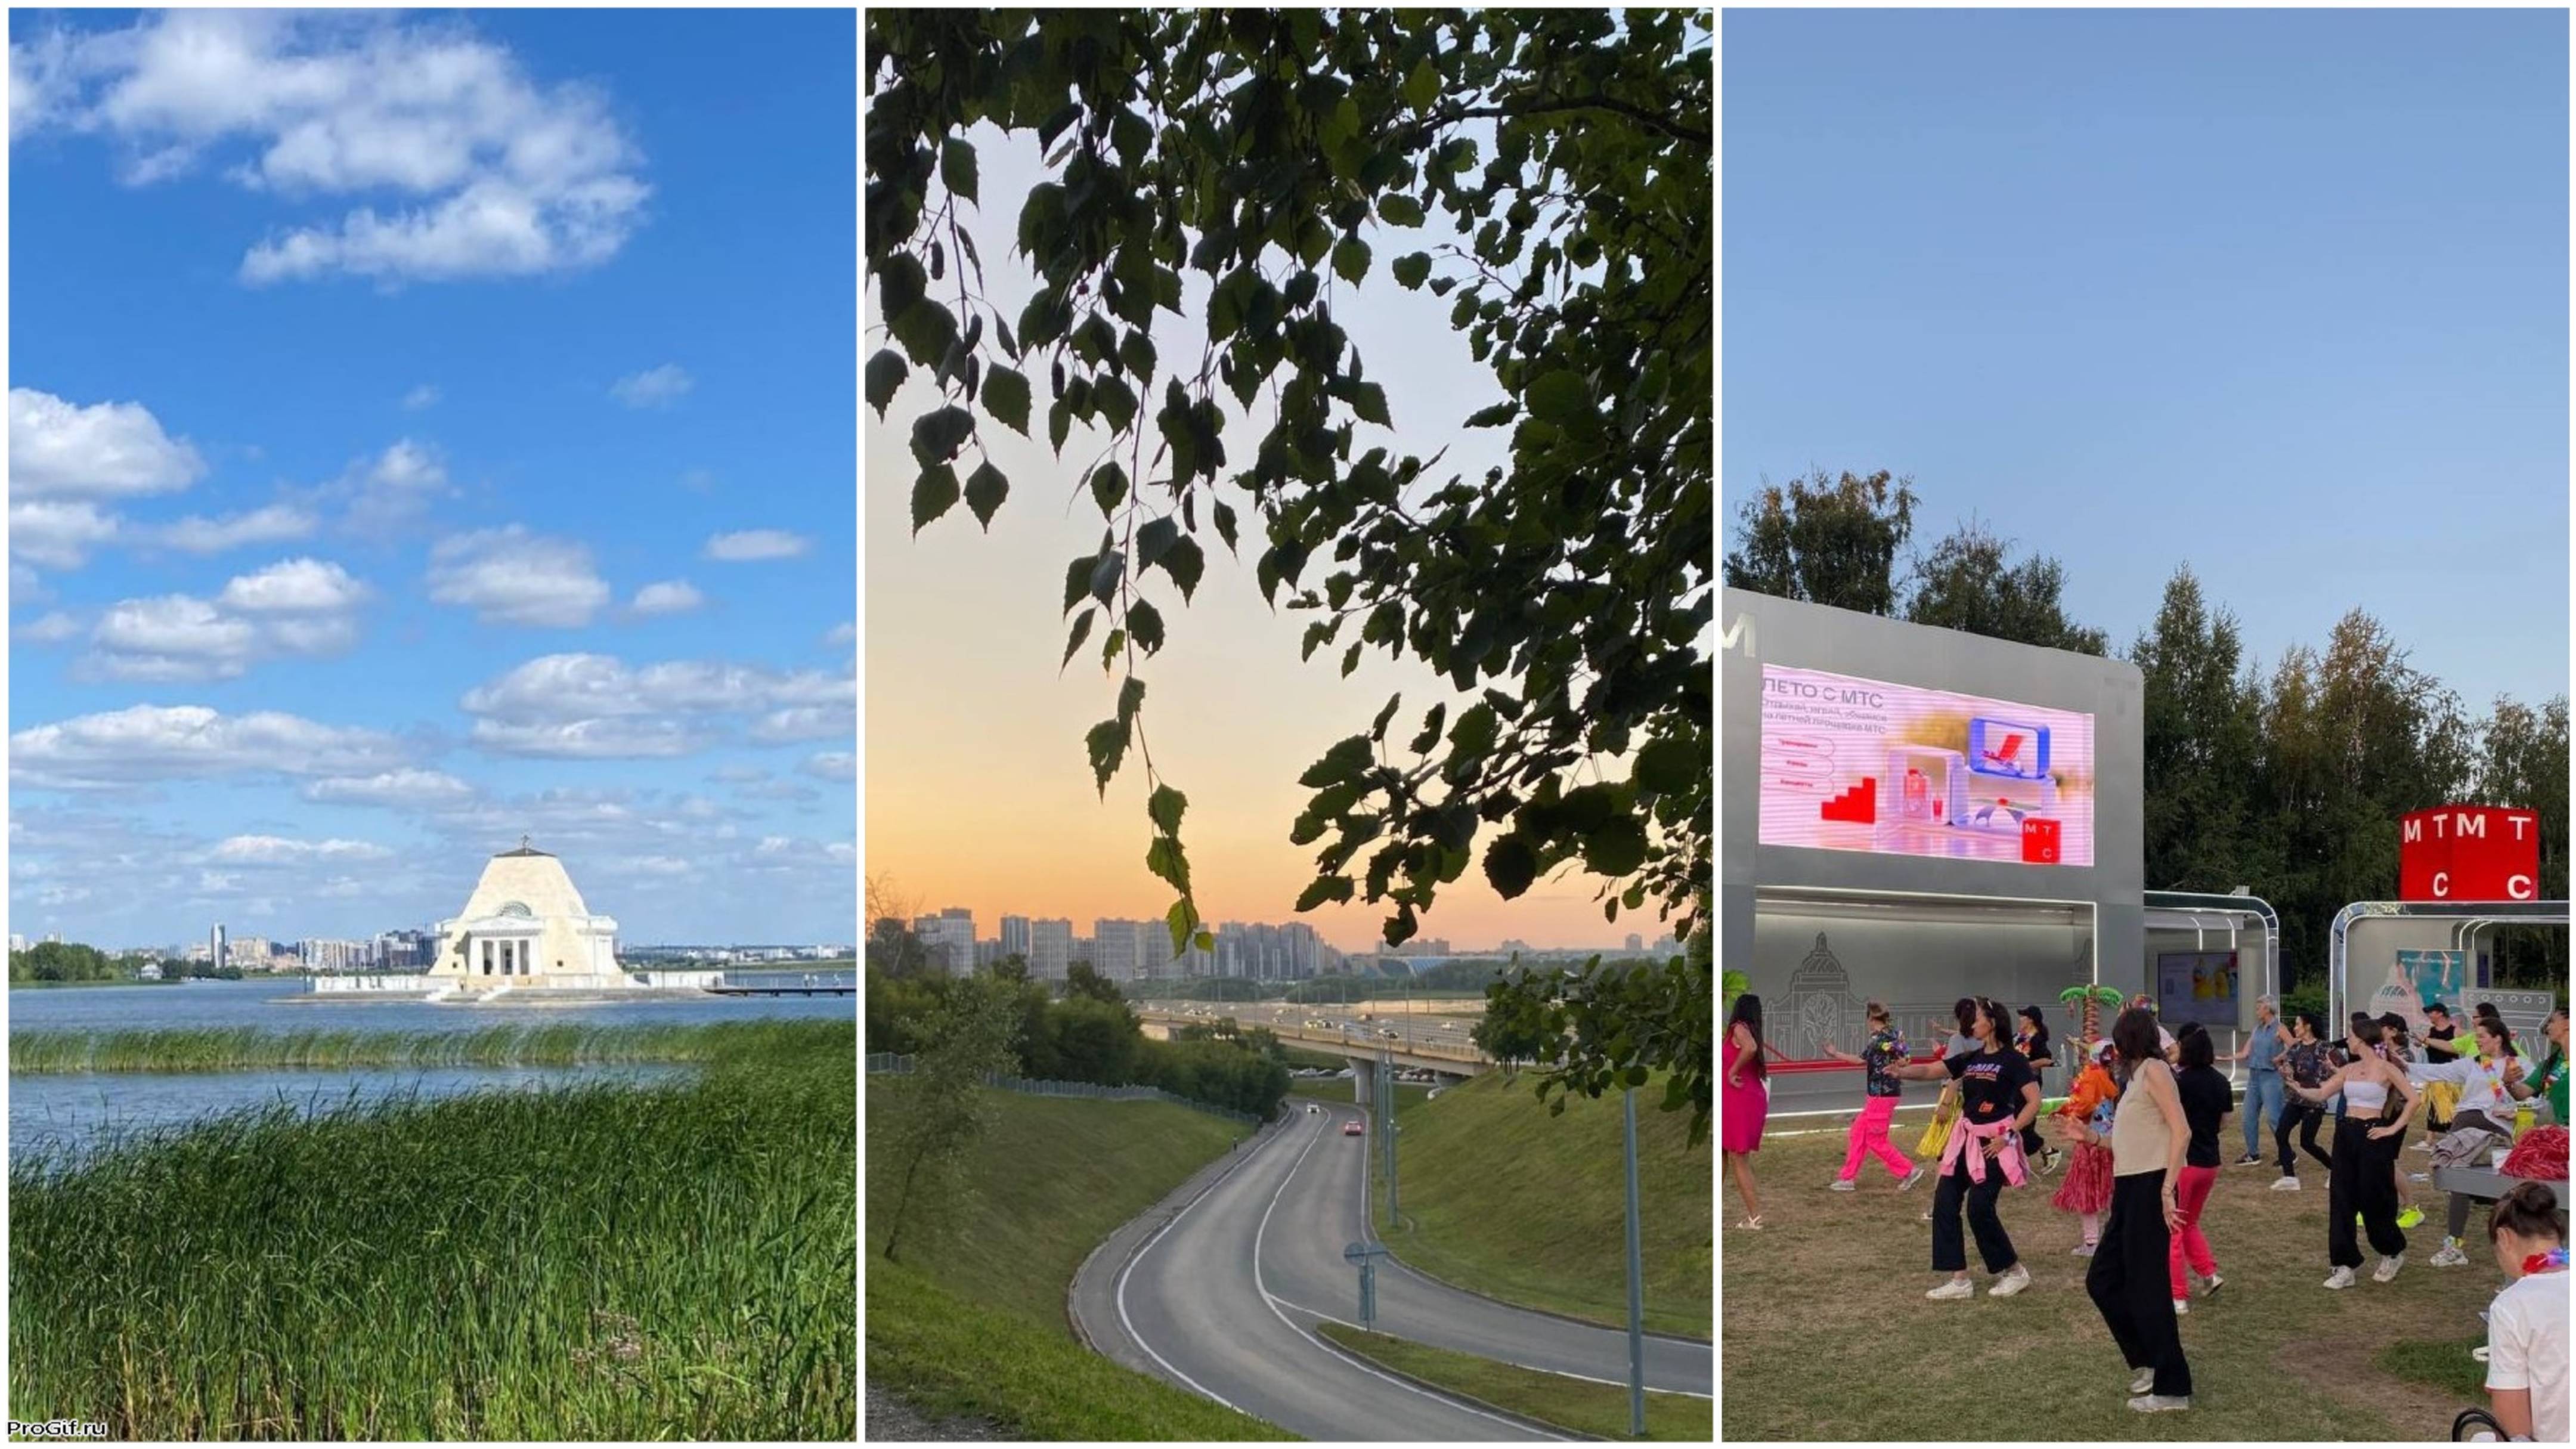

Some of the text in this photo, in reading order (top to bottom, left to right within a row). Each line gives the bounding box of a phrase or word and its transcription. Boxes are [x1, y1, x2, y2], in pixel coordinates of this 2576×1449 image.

[1761, 677, 1883, 708] ЛЕТО С МТС
